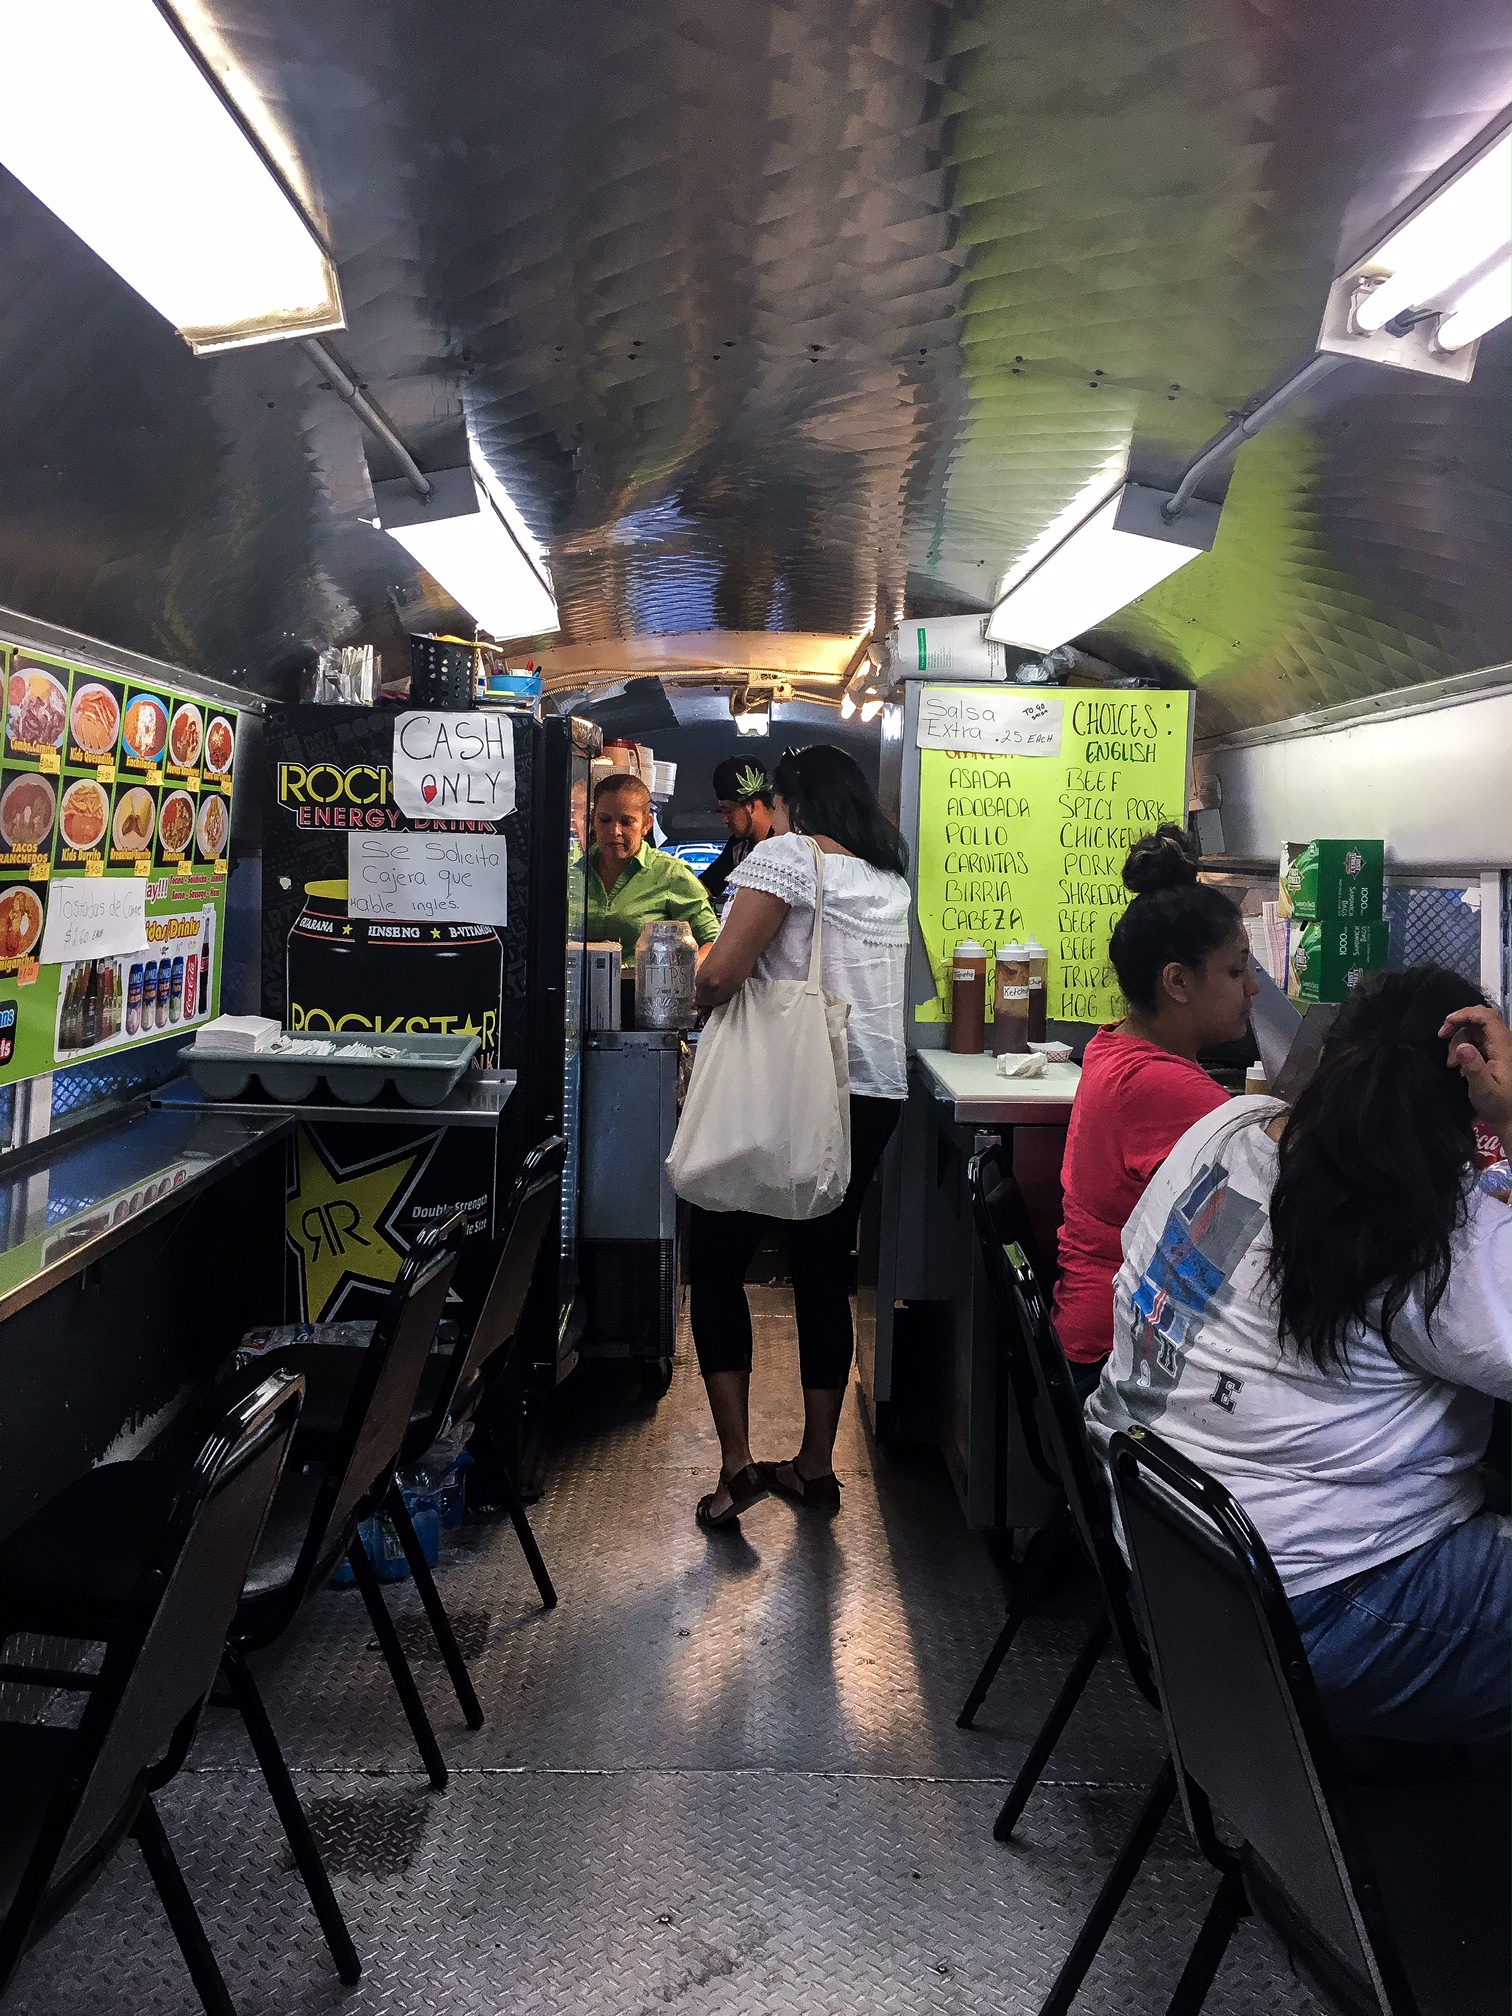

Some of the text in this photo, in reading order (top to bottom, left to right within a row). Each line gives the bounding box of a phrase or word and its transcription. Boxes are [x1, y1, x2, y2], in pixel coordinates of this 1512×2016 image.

[926, 698, 996, 724] Salsa
[1022, 707, 1034, 716] TO
[399, 715, 506, 760] CASH
[922, 717, 1054, 744] Extra .25 EACH
[70, 747, 83, 762] Kids
[1085, 741, 1157, 763] ENGLISH
[421, 770, 501, 807] ONLY
[949, 767, 1011, 789] ASADA
[1065, 767, 1122, 791] BEEF
[299, 806, 401, 828] ENERGY
[947, 797, 1031, 819] ADOBADA
[1058, 797, 1166, 822] SPICY PORK
[946, 822, 1008, 846] POLLO
[0, 853, 48, 864] RANCHEROS
[12, 843, 38, 853] TACOS
[61, 848, 101, 861] Kids Burrito
[361, 841, 500, 867] Se Solicita
[944, 852, 1029, 875] CARNITAS
[1063, 854, 1117, 876] PORK
[146, 878, 168, 903] ay!!!
[362, 865, 473, 895] Cajera que
[945, 880, 1012, 903] BIRRIA
[53, 885, 105, 919] Tostadas
[109, 897, 122, 921] de
[146, 915, 201, 943] idas/Drinks
[942, 907, 1025, 931] CABEZA
[1058, 908, 1099, 934] BEEF
[1060, 936, 1096, 961] BEEF
[646, 966, 688, 985] TIPS
[1060, 964, 1112, 989] TRIPE
[1061, 992, 1098, 1018] HOG
[412, 1203, 449, 1218] Doubl
